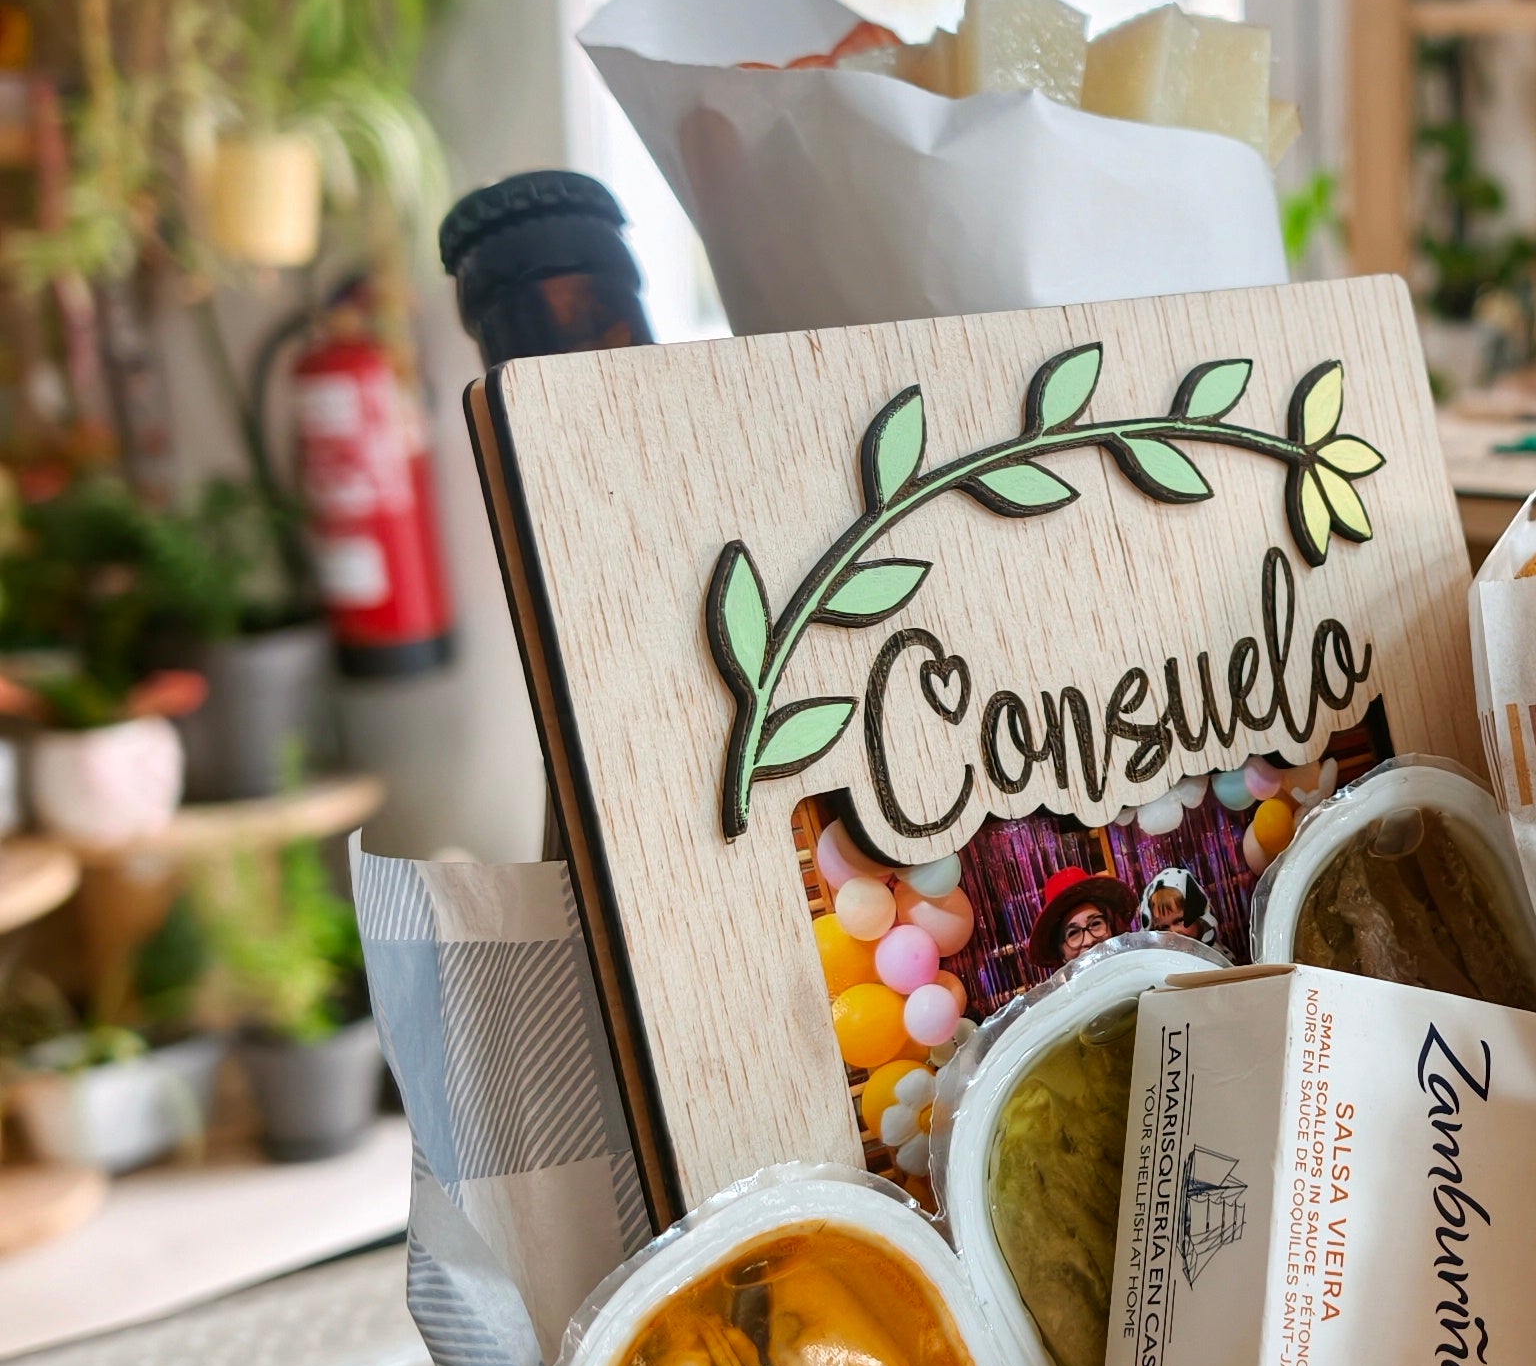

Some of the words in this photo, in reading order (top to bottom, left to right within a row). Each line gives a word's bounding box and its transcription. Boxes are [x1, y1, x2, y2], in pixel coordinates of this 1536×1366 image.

[863, 546, 1373, 839] Consuelo
[1303, 988, 1319, 1044] NOIRS
[1317, 1012, 1333, 1074] SMALL
[1167, 1030, 1182, 1066] LA
[1302, 1049, 1315, 1074] EN
[1141, 1083, 1157, 1141] YOUR
[1297, 1079, 1313, 1142] SAUCE
[1310, 1080, 1329, 1179] SCALLOPS
[1150, 1070, 1181, 1263] MARISQUERÍA
[1294, 1147, 1308, 1173] DE
[1329, 1101, 1354, 1204] SALSA
[1132, 1145, 1151, 1243] SHELLFISH
[1308, 1184, 1321, 1205] IN
[1129, 1246, 1142, 1272] AT
[1286, 1178, 1306, 1286] COQUILLES
[1303, 1210, 1319, 1276] SAUCE
[1146, 1267, 1164, 1306] EN
[1321, 1218, 1347, 1322] VIEIRA
[1123, 1276, 1138, 1339] HOME
